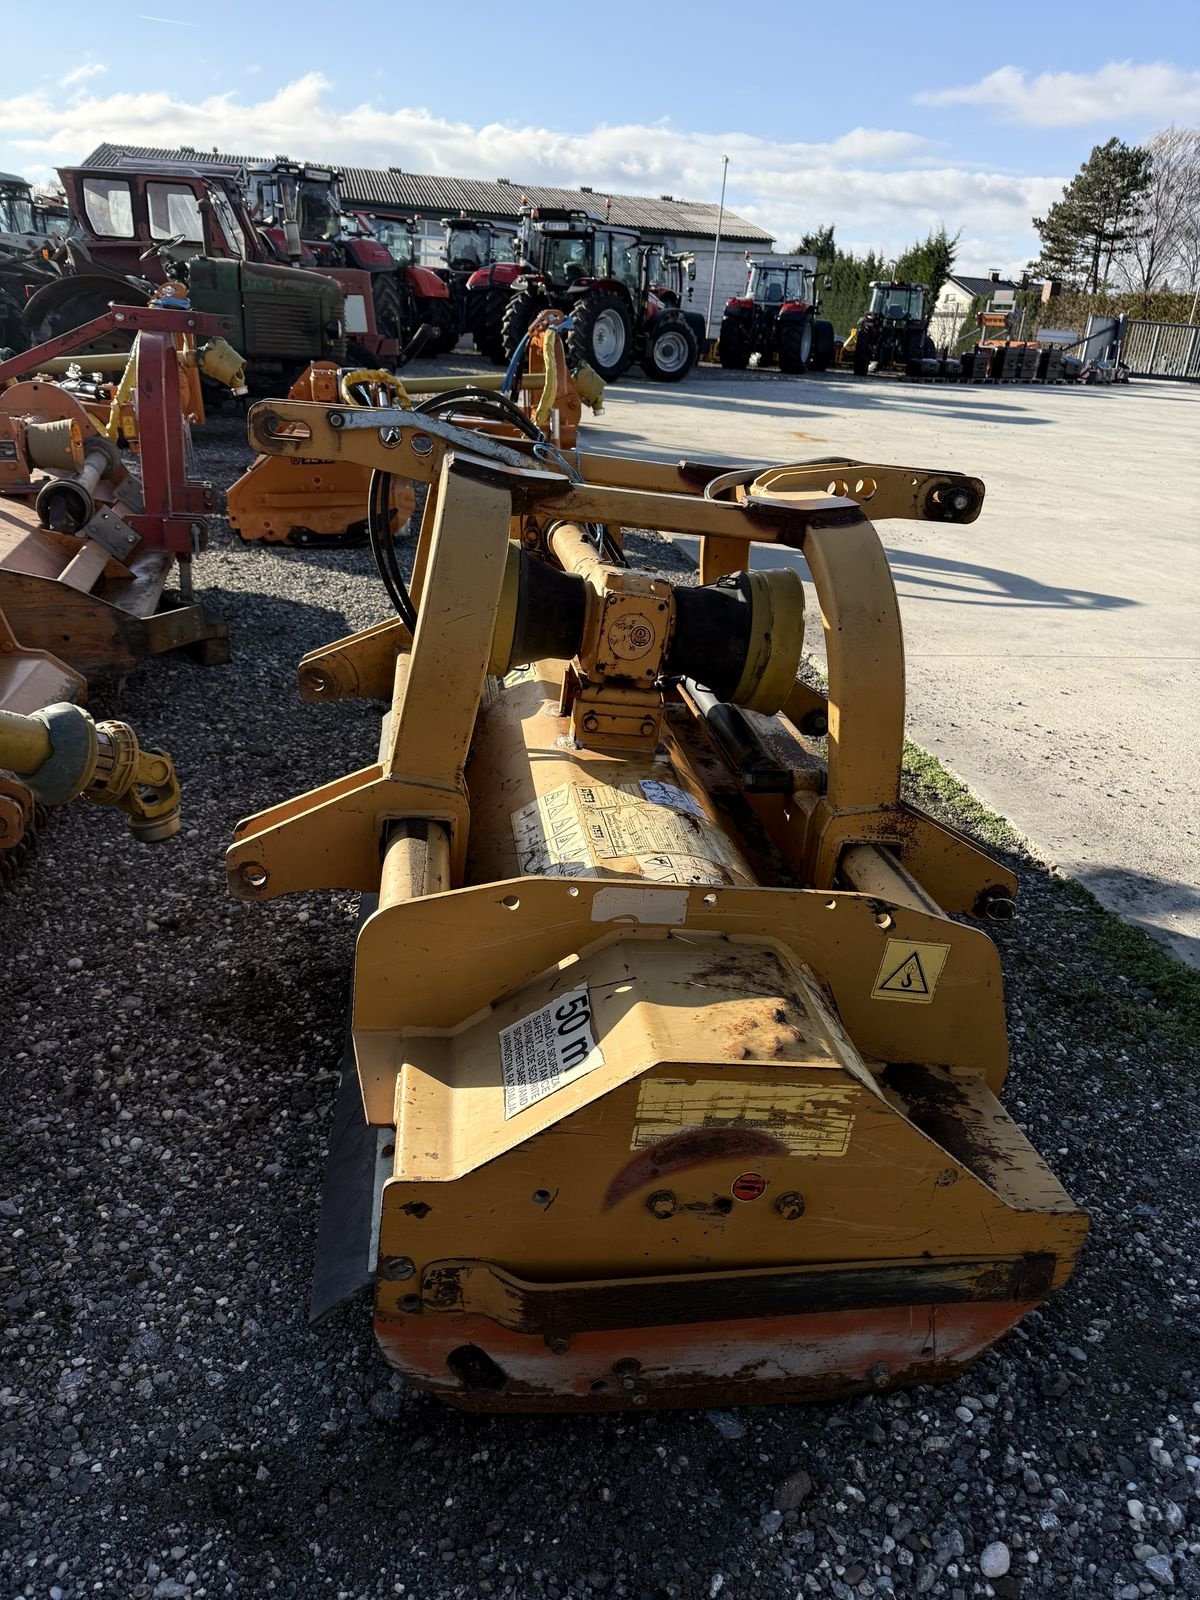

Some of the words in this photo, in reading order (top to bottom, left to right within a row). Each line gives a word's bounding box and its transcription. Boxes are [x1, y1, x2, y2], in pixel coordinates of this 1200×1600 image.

[533, 1015, 543, 1044] SAFETY
[542, 1010, 553, 1042] DISTANZA
[555, 995, 591, 1036] 50
[503, 1032, 513, 1074] VARNOSTNA
[524, 1021, 535, 1055] DISTANCES
[561, 1036, 590, 1073] m
[513, 1027, 527, 1105] SICHERHEITSABSTAND
[528, 1065, 540, 1100] SECURITE
[536, 1050, 550, 1095] DISTANCE
[547, 1047, 561, 1088] SICUREZZA
[505, 1074, 516, 1113] RAZDALJA
